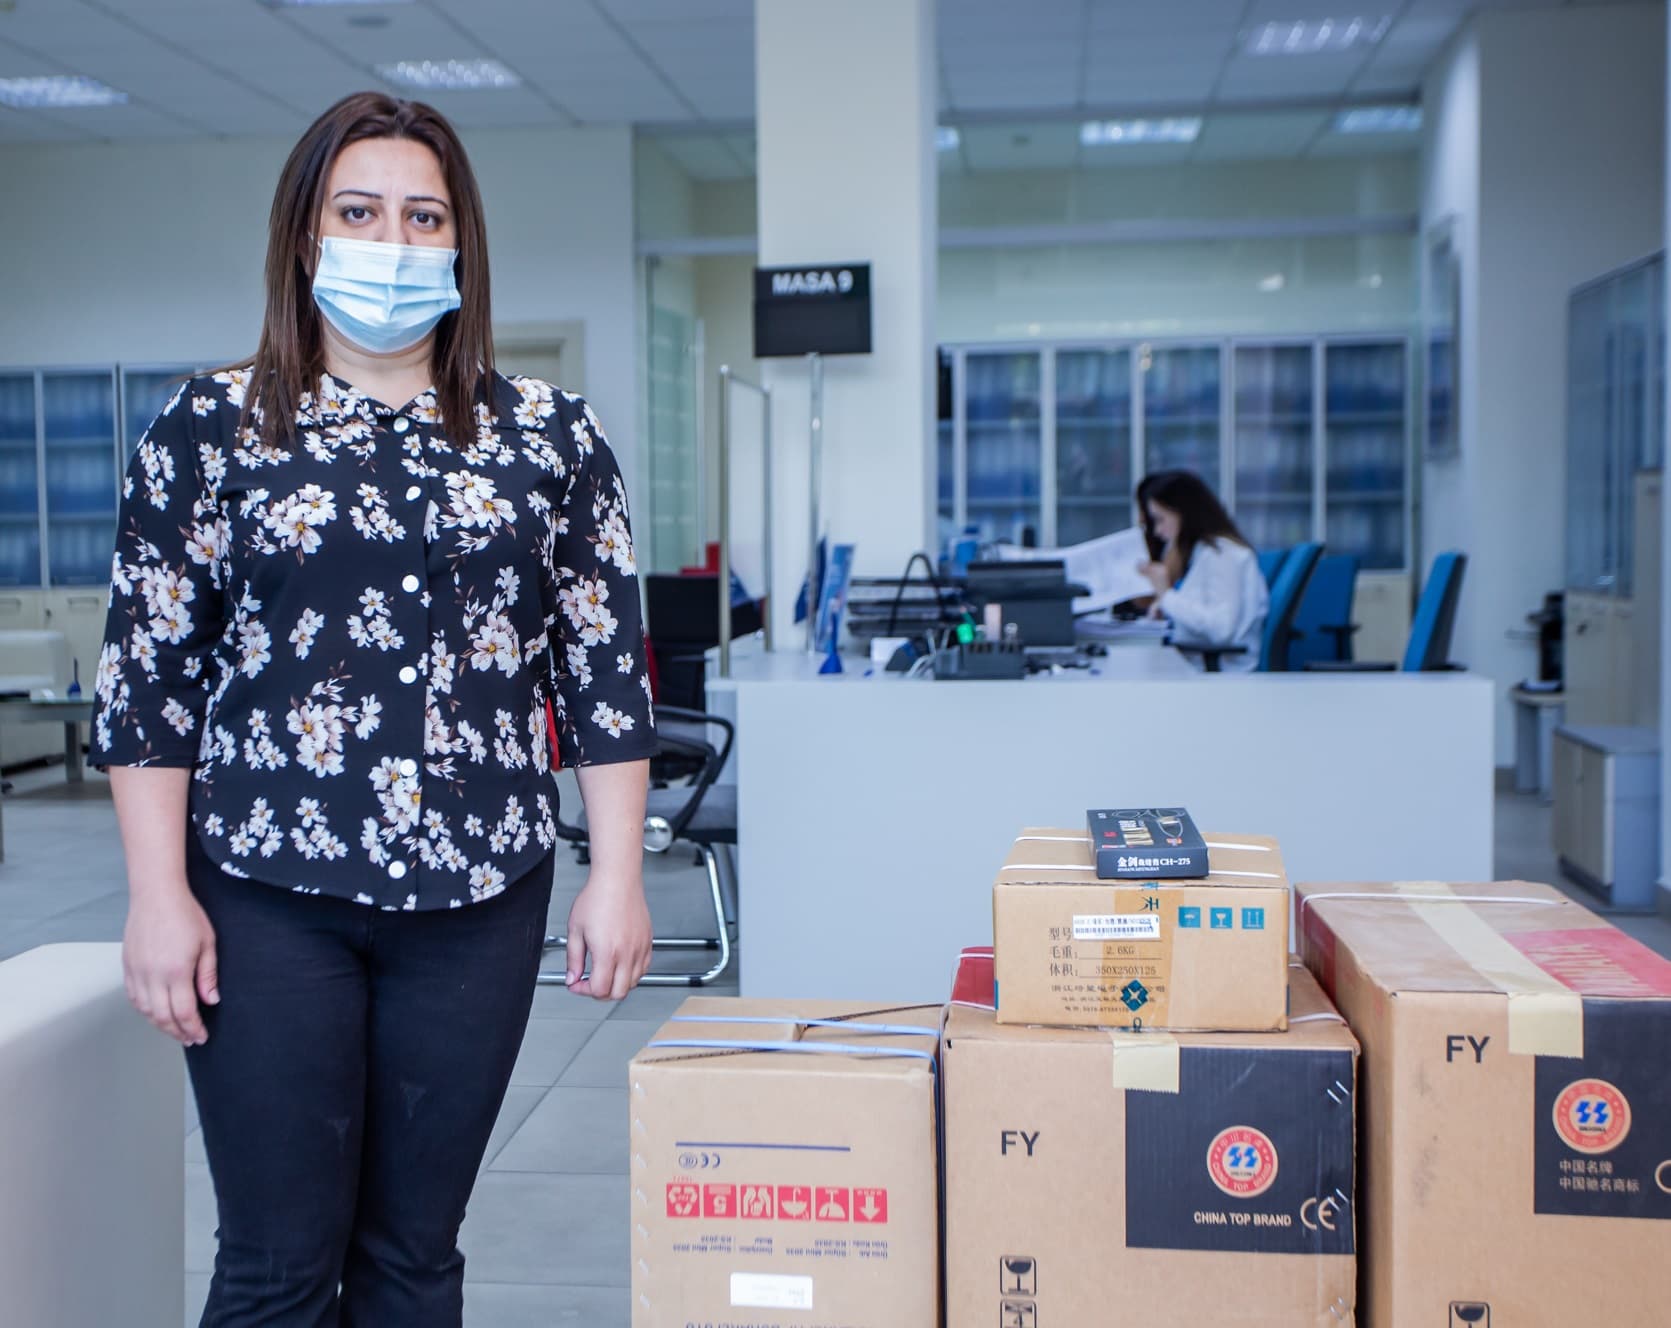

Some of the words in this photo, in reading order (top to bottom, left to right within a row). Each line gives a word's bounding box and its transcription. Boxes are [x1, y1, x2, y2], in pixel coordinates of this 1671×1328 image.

[772, 271, 837, 296] MASA
[837, 269, 854, 293] 9
[1446, 1035, 1490, 1063] FY
[1000, 1130, 1040, 1157] FY
[1194, 1211, 1228, 1225] CHINA
[1229, 1212, 1251, 1226] TOP
[1253, 1213, 1292, 1227] BRAND
[1300, 1197, 1336, 1230] CE
